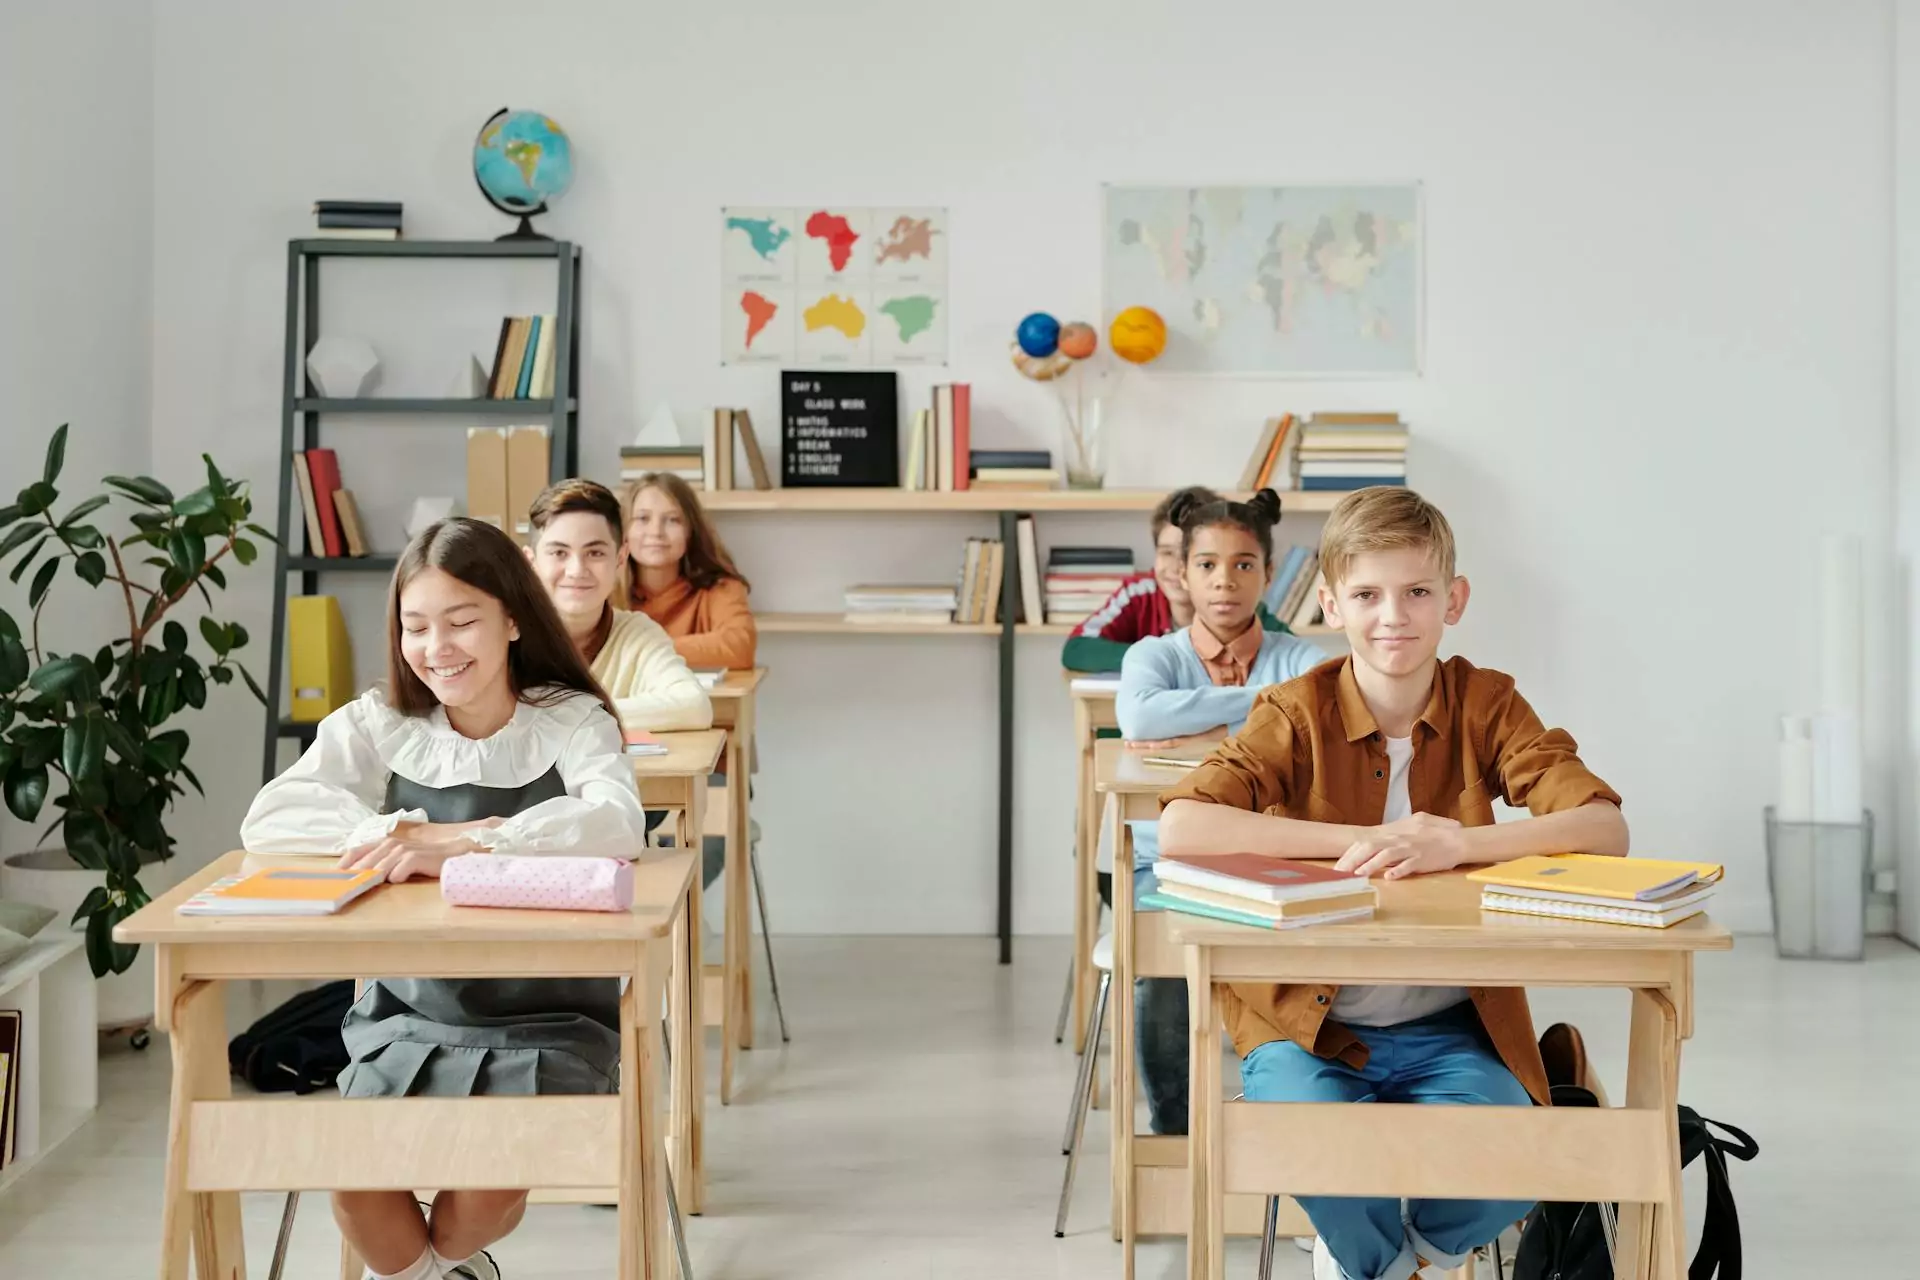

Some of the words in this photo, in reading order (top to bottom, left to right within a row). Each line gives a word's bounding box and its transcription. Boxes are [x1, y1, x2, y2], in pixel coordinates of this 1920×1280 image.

[791, 381, 811, 393] DAY
[804, 398, 836, 410] CLASS
[840, 398, 867, 410] WORK
[796, 415, 829, 427] MATHS
[788, 427, 795, 439] 2
[797, 427, 868, 439] INFORMATICS
[797, 440, 831, 451] BREAK
[798, 453, 842, 464] ENGLISH
[798, 464, 839, 475] SCIENCE
